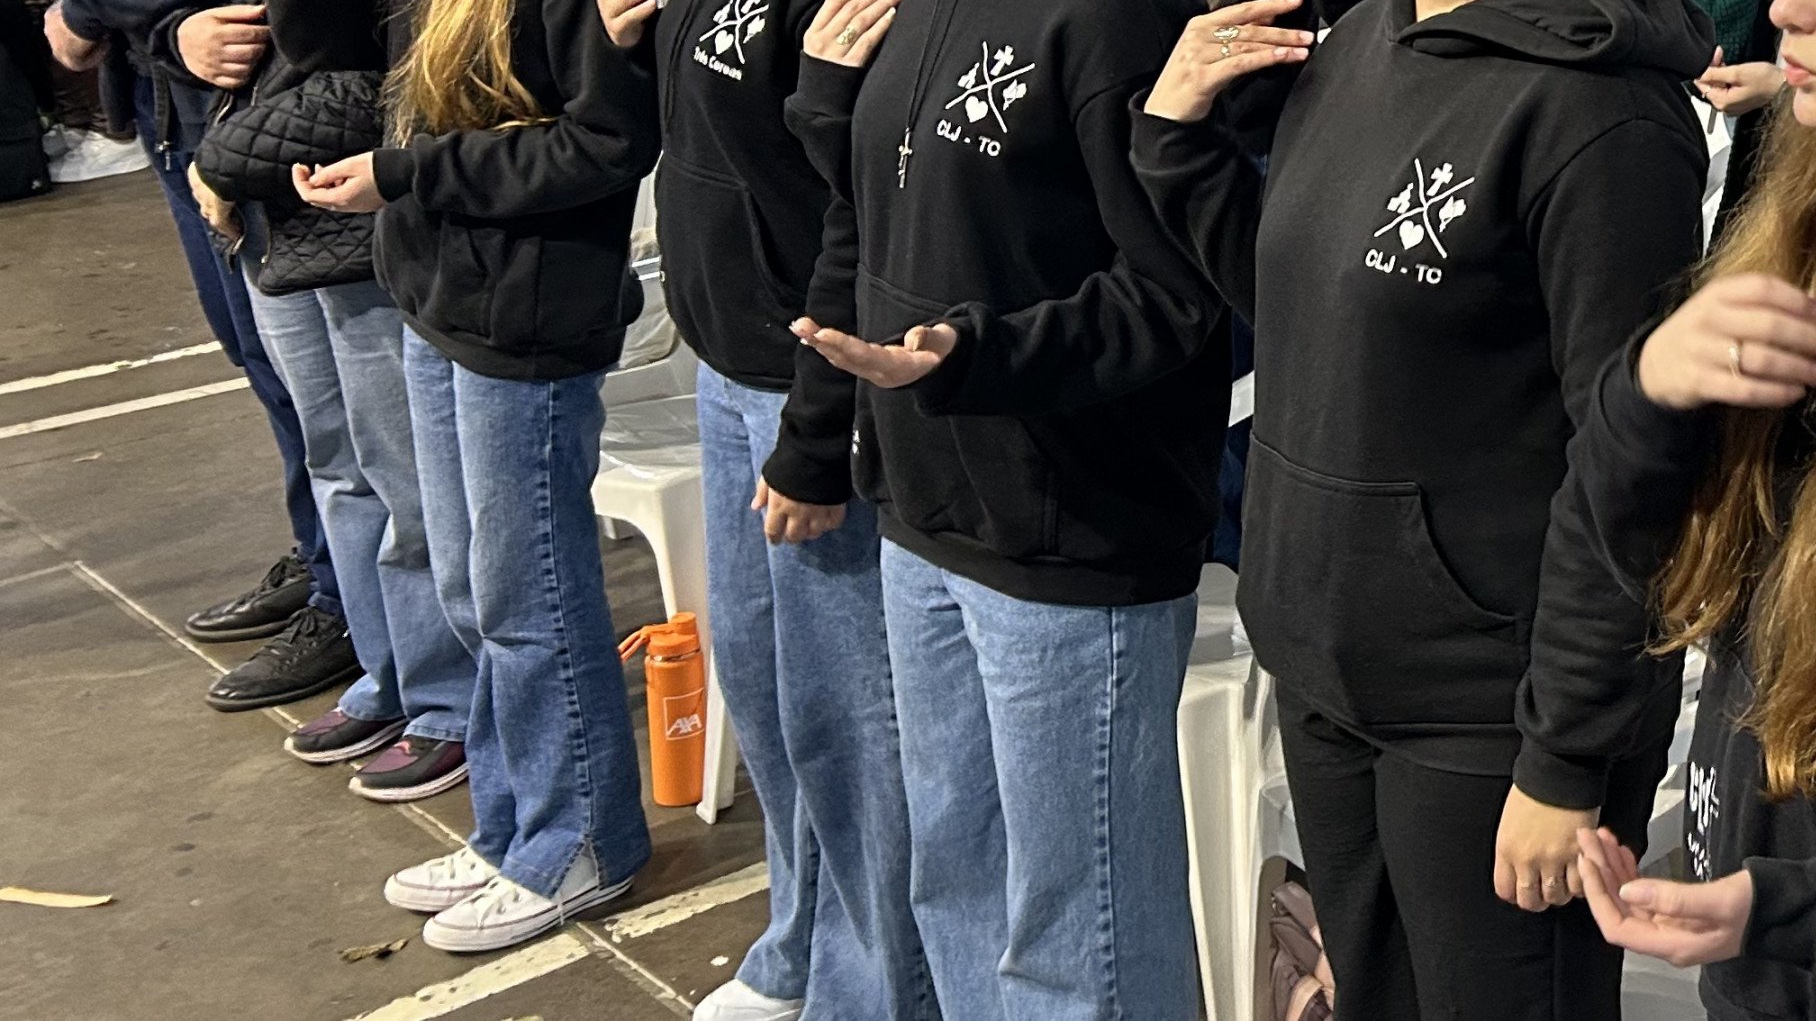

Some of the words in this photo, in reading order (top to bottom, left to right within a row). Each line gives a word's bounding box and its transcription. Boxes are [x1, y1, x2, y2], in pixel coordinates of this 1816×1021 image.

[936, 119, 962, 142] CLJ
[978, 135, 1001, 157] TO
[1364, 248, 1396, 274] CLJ
[1415, 263, 1442, 285] TO
[667, 714, 702, 736] AXA
